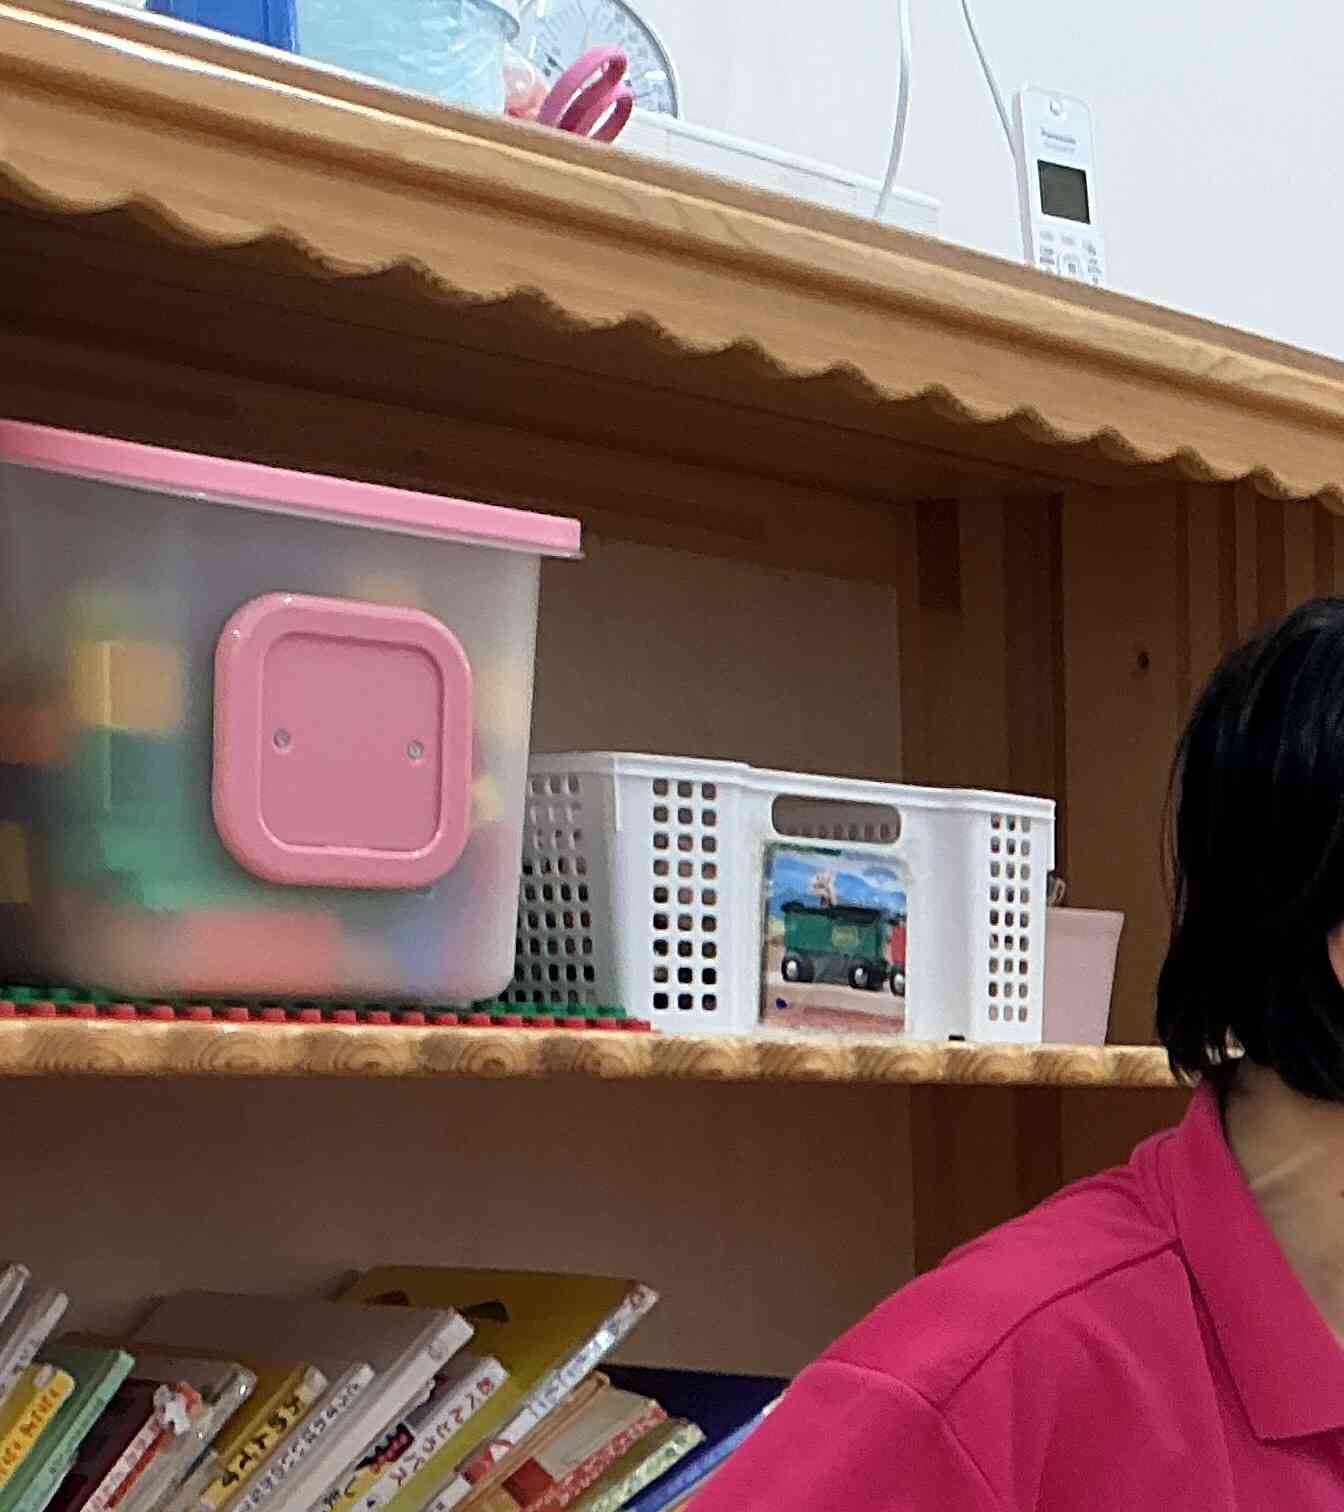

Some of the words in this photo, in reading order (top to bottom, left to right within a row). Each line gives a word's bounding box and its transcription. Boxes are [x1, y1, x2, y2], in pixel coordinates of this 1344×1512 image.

[388, 1376, 495, 1488] おべんとうバス
